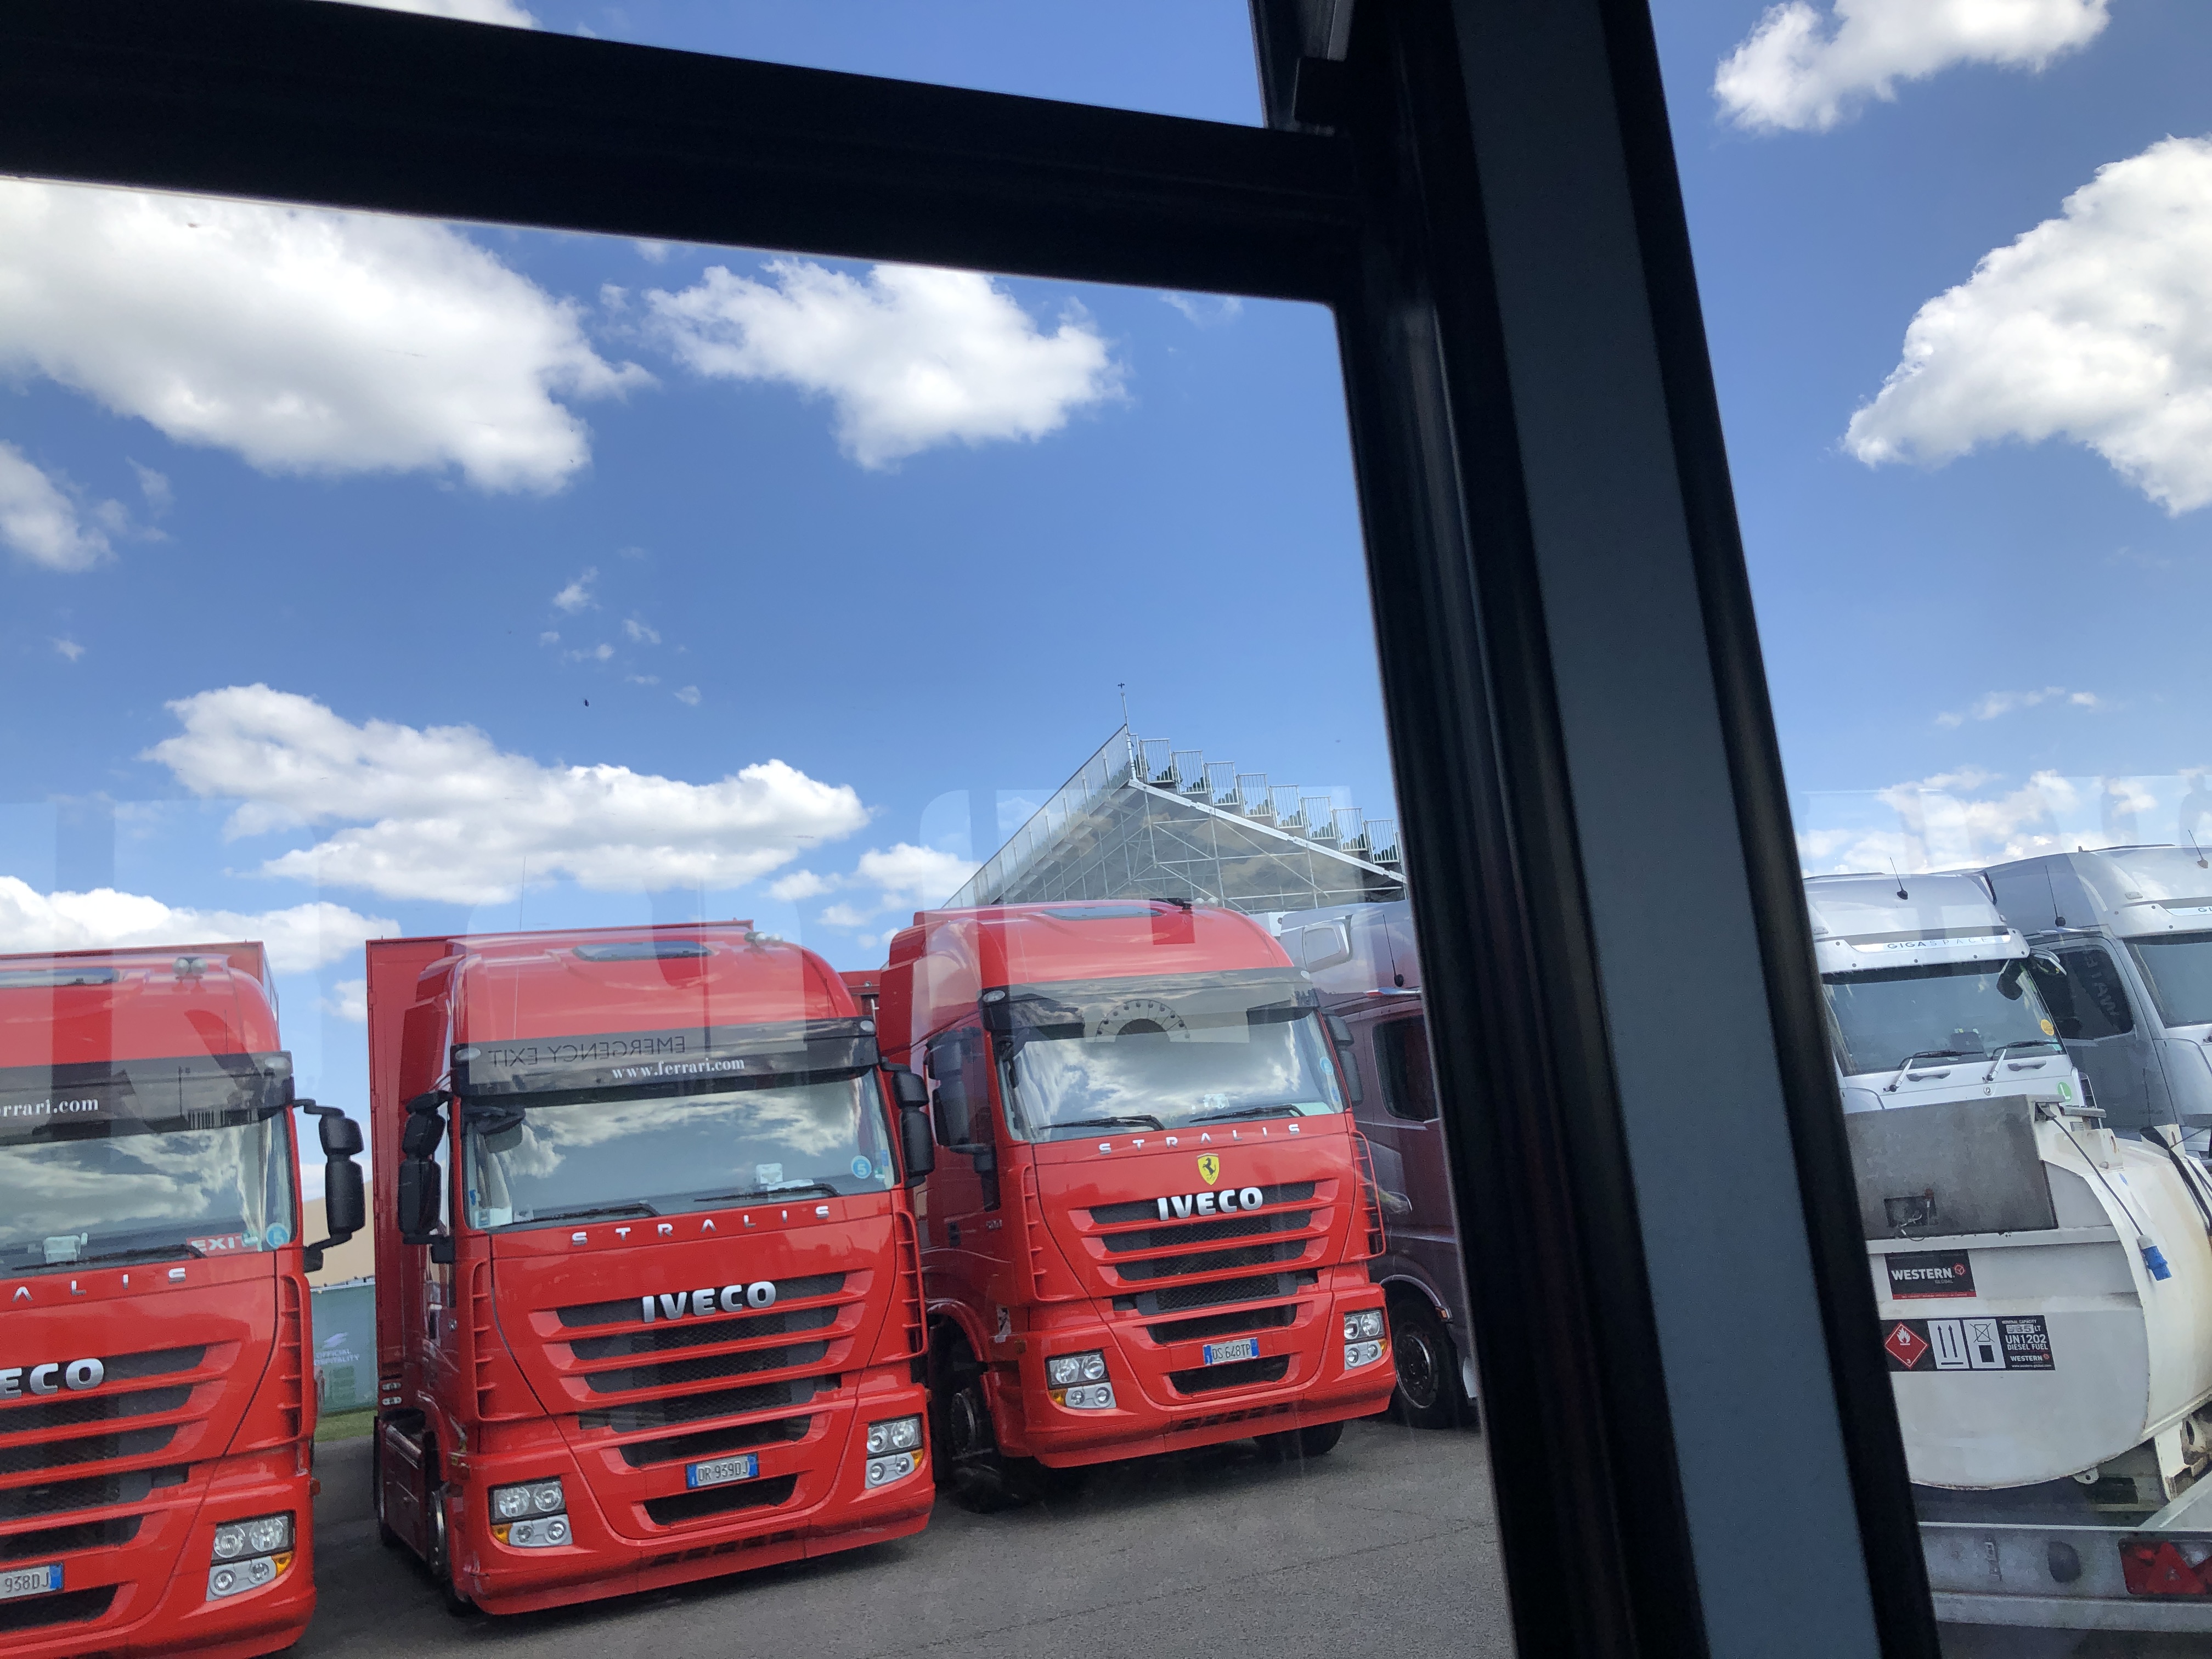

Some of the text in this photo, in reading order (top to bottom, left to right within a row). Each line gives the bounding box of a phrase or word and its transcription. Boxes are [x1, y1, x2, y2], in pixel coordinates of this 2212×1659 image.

[612, 1058, 745, 1079] www.ferrari.com
[0, 1099, 98, 1117] rrari.com
[1099, 1124, 1300, 1155] STRALIS
[1158, 1187, 1263, 1220] IVECO
[572, 1205, 830, 1245] STRALIS
[642, 1281, 776, 1323] IVECO
[2005, 1334, 2047, 1344] UN1202
[1212, 1348, 1223, 1359] DS
[1225, 1344, 1250, 1358] 648TP
[698, 1466, 712, 1481] DR
[714, 1460, 749, 1479] 939DJ
[4, 1572, 49, 1593] 938DJ
